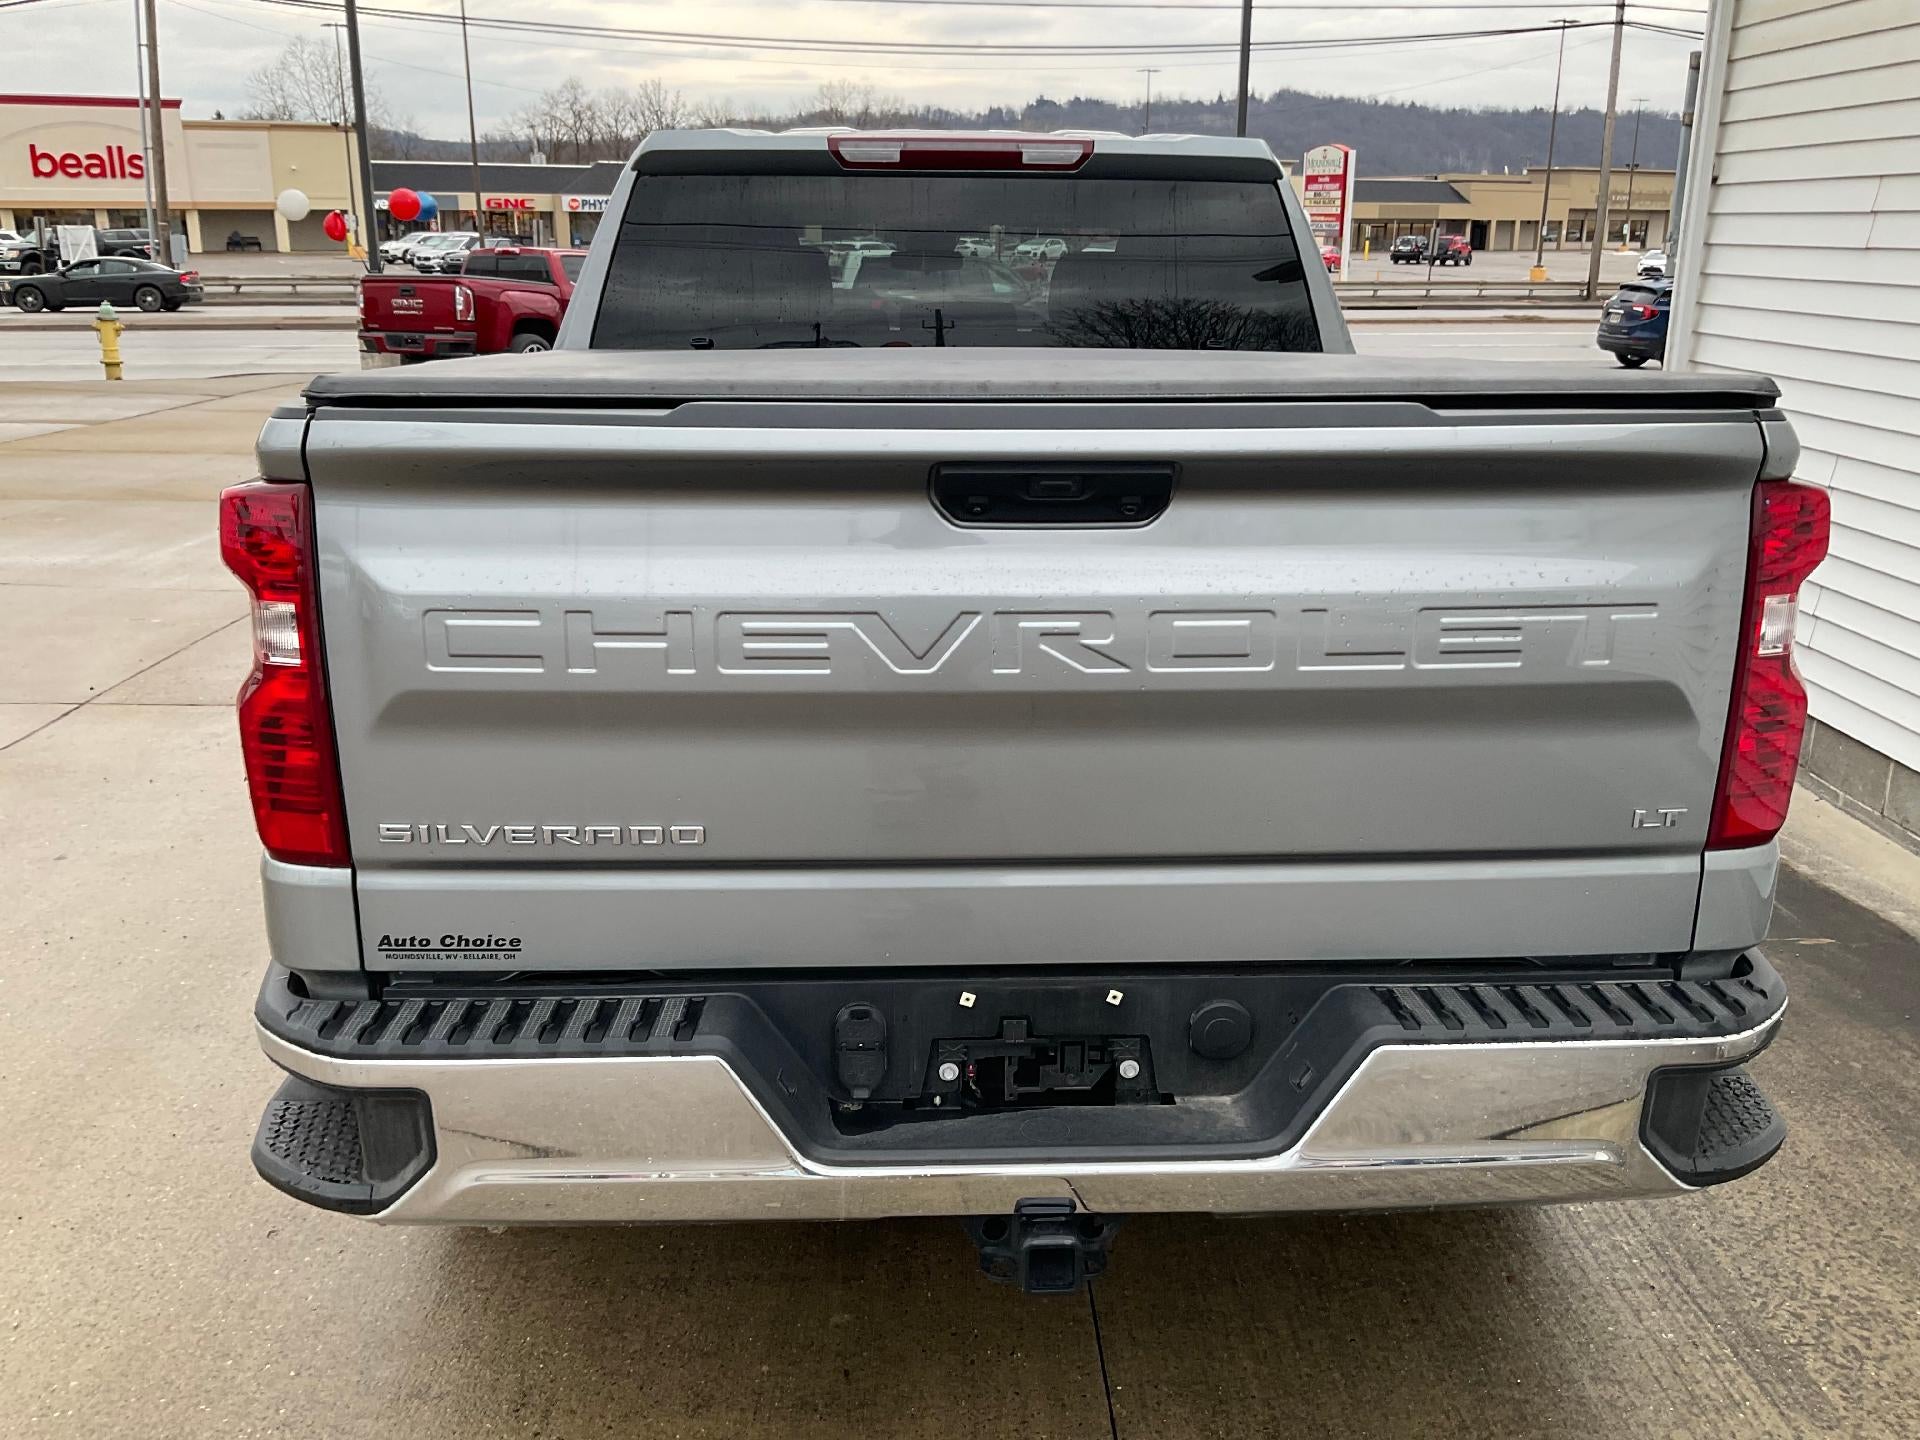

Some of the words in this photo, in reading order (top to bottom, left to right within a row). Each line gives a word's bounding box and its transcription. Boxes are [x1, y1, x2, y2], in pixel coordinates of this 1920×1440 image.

[29, 143, 144, 179] bealls
[486, 198, 535, 209] GNC
[391, 299, 423, 308] GMC
[423, 604, 1658, 675] CHEVROLET
[1632, 808, 1688, 828] LT
[378, 823, 706, 846] SILVERADO
[378, 934, 431, 948] Auto
[440, 934, 522, 948] Choice
[385, 953, 444, 961] MOUNDSVILLE,
